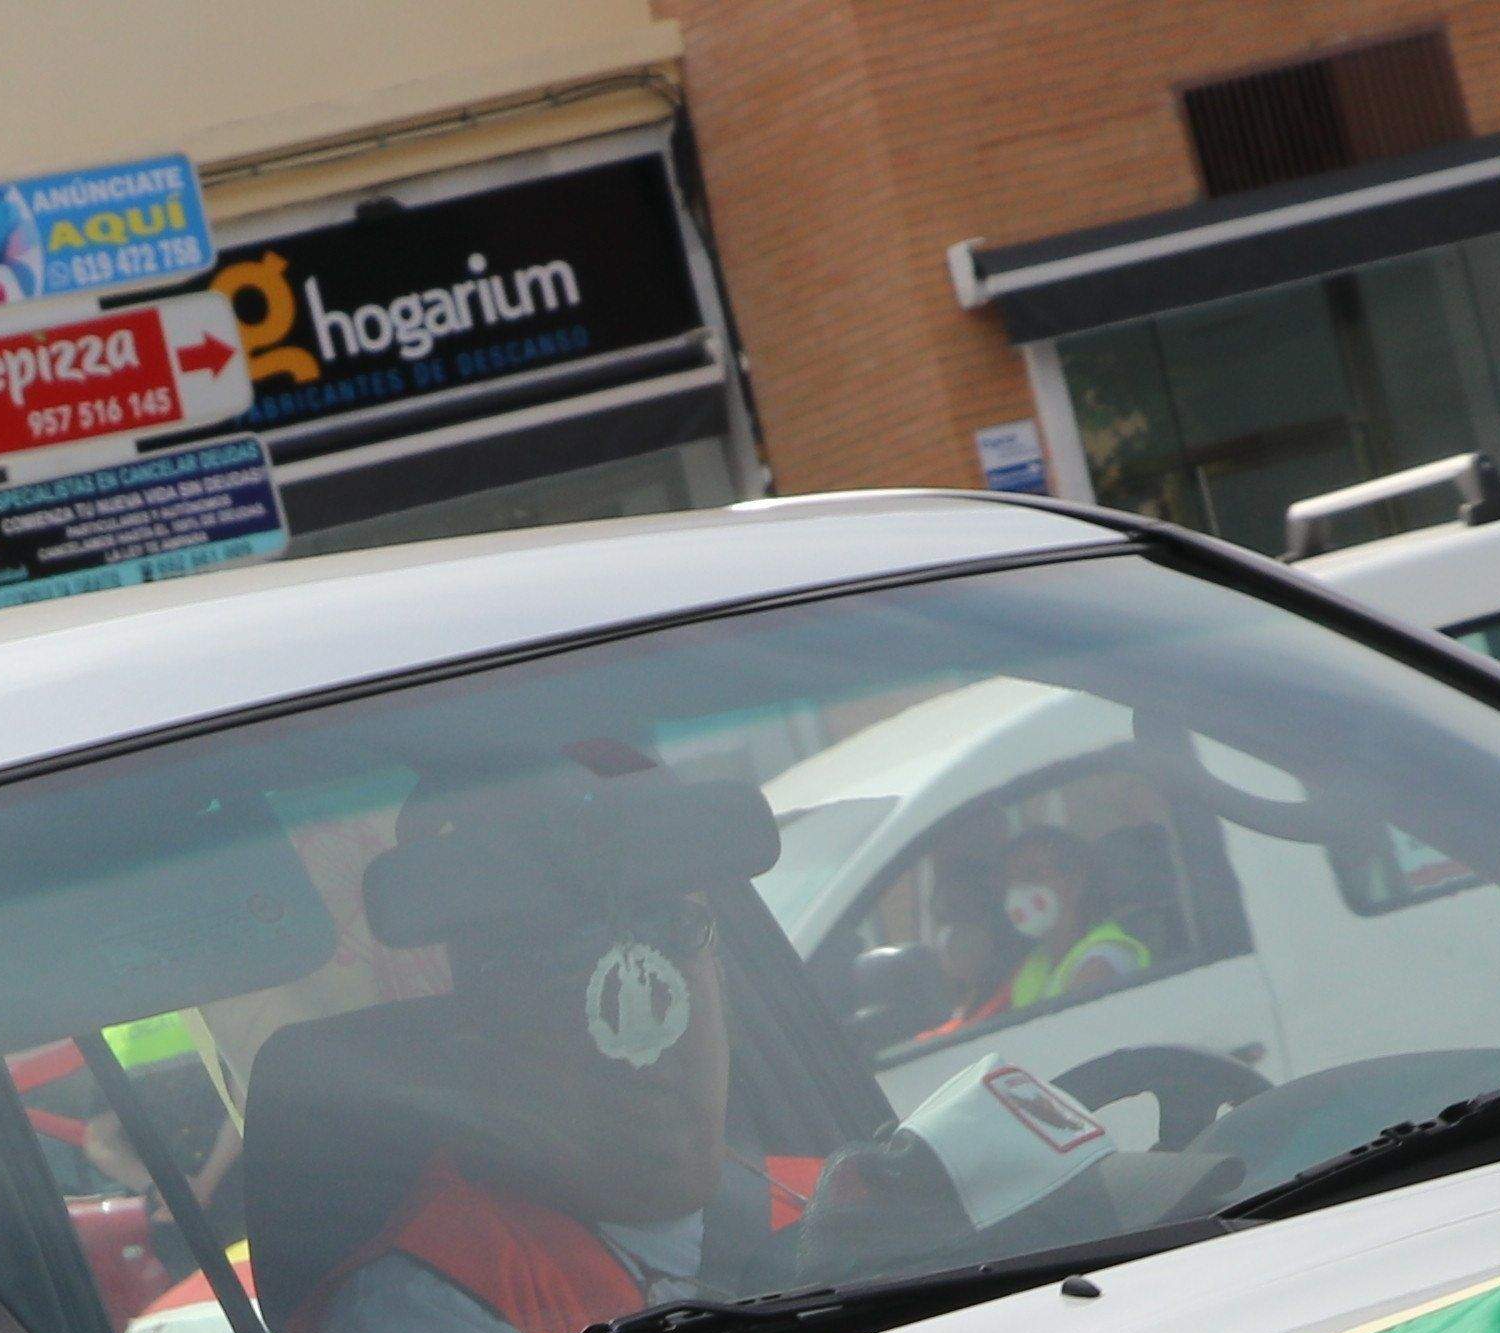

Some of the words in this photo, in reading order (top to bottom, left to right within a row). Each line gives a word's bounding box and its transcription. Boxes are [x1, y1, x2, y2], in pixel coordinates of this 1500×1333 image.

[31, 165, 185, 212] ANÚNCIATE
[47, 194, 187, 253] AQUÍ
[303, 252, 582, 362] hogarium
[412, 356, 448, 388] DE
[456, 325, 590, 378] DESCANSO
[27, 404, 73, 438] 957
[77, 397, 124, 430] 516
[128, 386, 171, 418] 145
[118, 451, 198, 486] CANCELAR
[197, 440, 259, 470] DEUDAS
